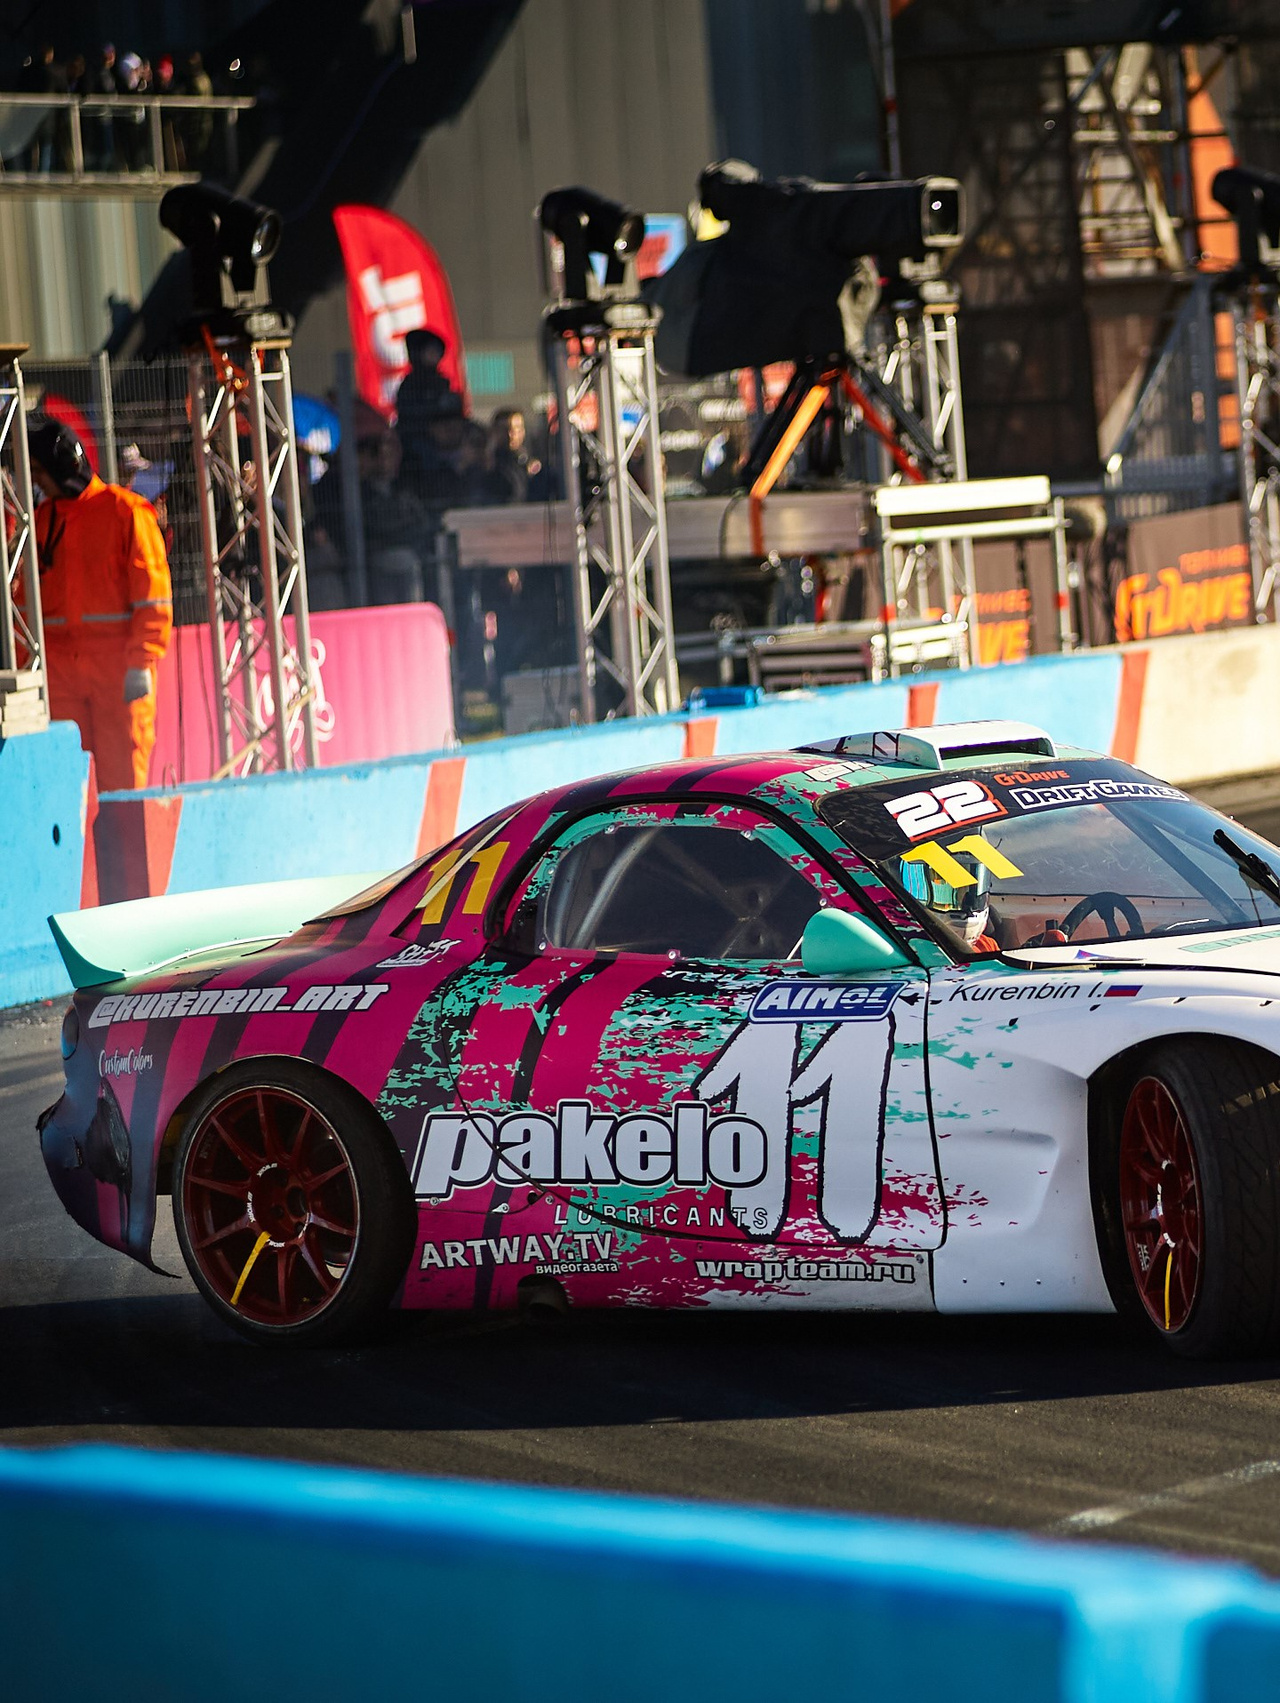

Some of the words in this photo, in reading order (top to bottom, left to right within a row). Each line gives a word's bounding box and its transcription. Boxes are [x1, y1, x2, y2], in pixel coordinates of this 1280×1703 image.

[883, 780, 1005, 841] 22
[900, 834, 1024, 888] 11
[421, 841, 510, 925] 11
[756, 984, 891, 1011] AIMOL
[949, 982, 1080, 1003] Kurenbin
[692, 1010, 895, 1242] 11
[413, 1101, 770, 1199] pakelo
[554, 1204, 768, 1228] LUBRICANTS
[420, 1232, 613, 1269] ARTWAY.TV
[535, 1262, 618, 1275] видеогазета
[695, 1257, 916, 1283] wrapteam.ru
